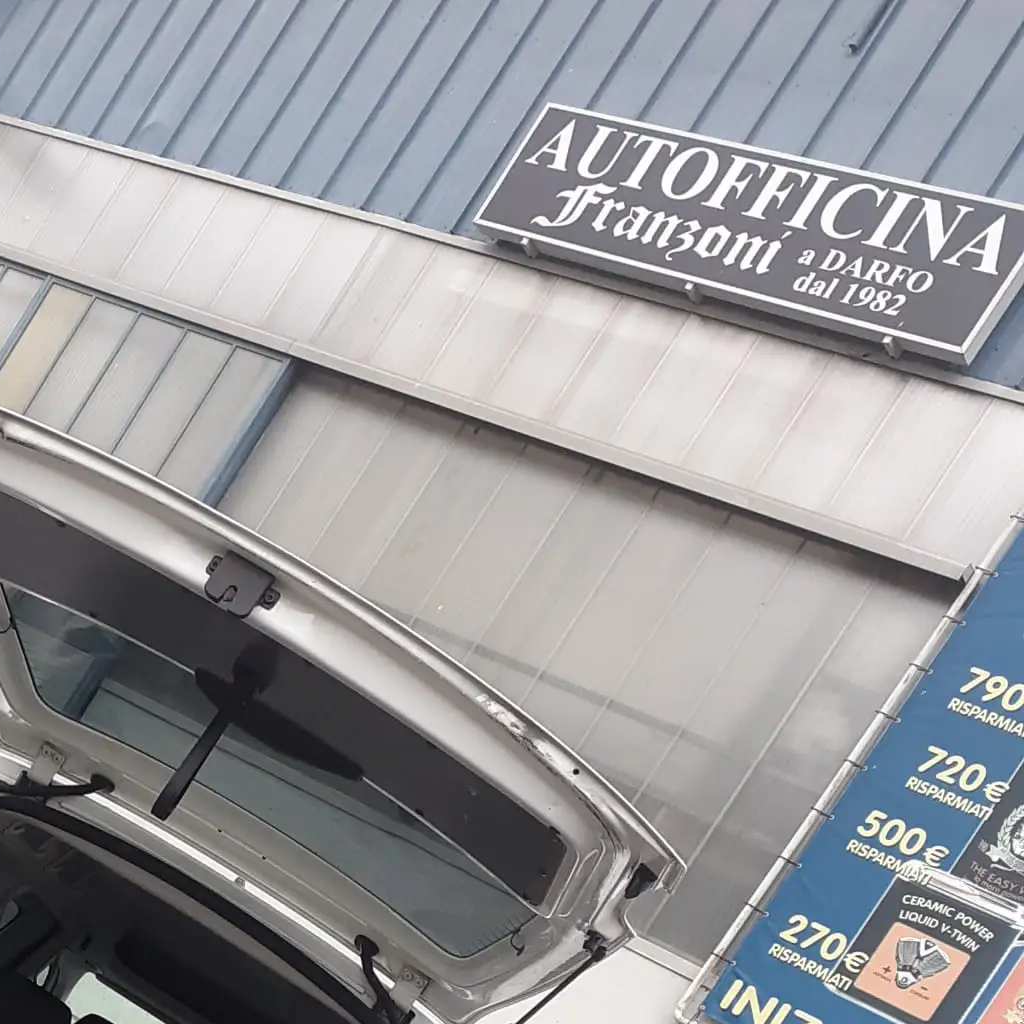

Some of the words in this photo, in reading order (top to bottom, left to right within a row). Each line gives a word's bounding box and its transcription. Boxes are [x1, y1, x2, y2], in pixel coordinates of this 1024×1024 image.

[524, 118, 1007, 275] AUTOFFICINA
[530, 183, 792, 275] Franzoni
[793, 272, 839, 299] dal
[840, 283, 906, 316] 1982
[797, 248, 816, 266] a
[819, 248, 934, 293] DARFO
[947, 697, 1024, 739] RISPARMIA
[918, 745, 1010, 803] 720€
[904, 776, 993, 820] RISPARMIATI
[857, 810, 950, 867] 500€
[846, 839, 931, 886] RISPARMIATI
[987, 873, 1018, 891] EASY
[899, 909, 939, 928] LIQUID
[940, 923, 980, 953] V-TWIN
[902, 894, 956, 918] CERAMIC
[954, 912, 994, 942] POWER
[768, 943, 853, 991] RISPARMIATI
[779, 914, 869, 973] 270€
